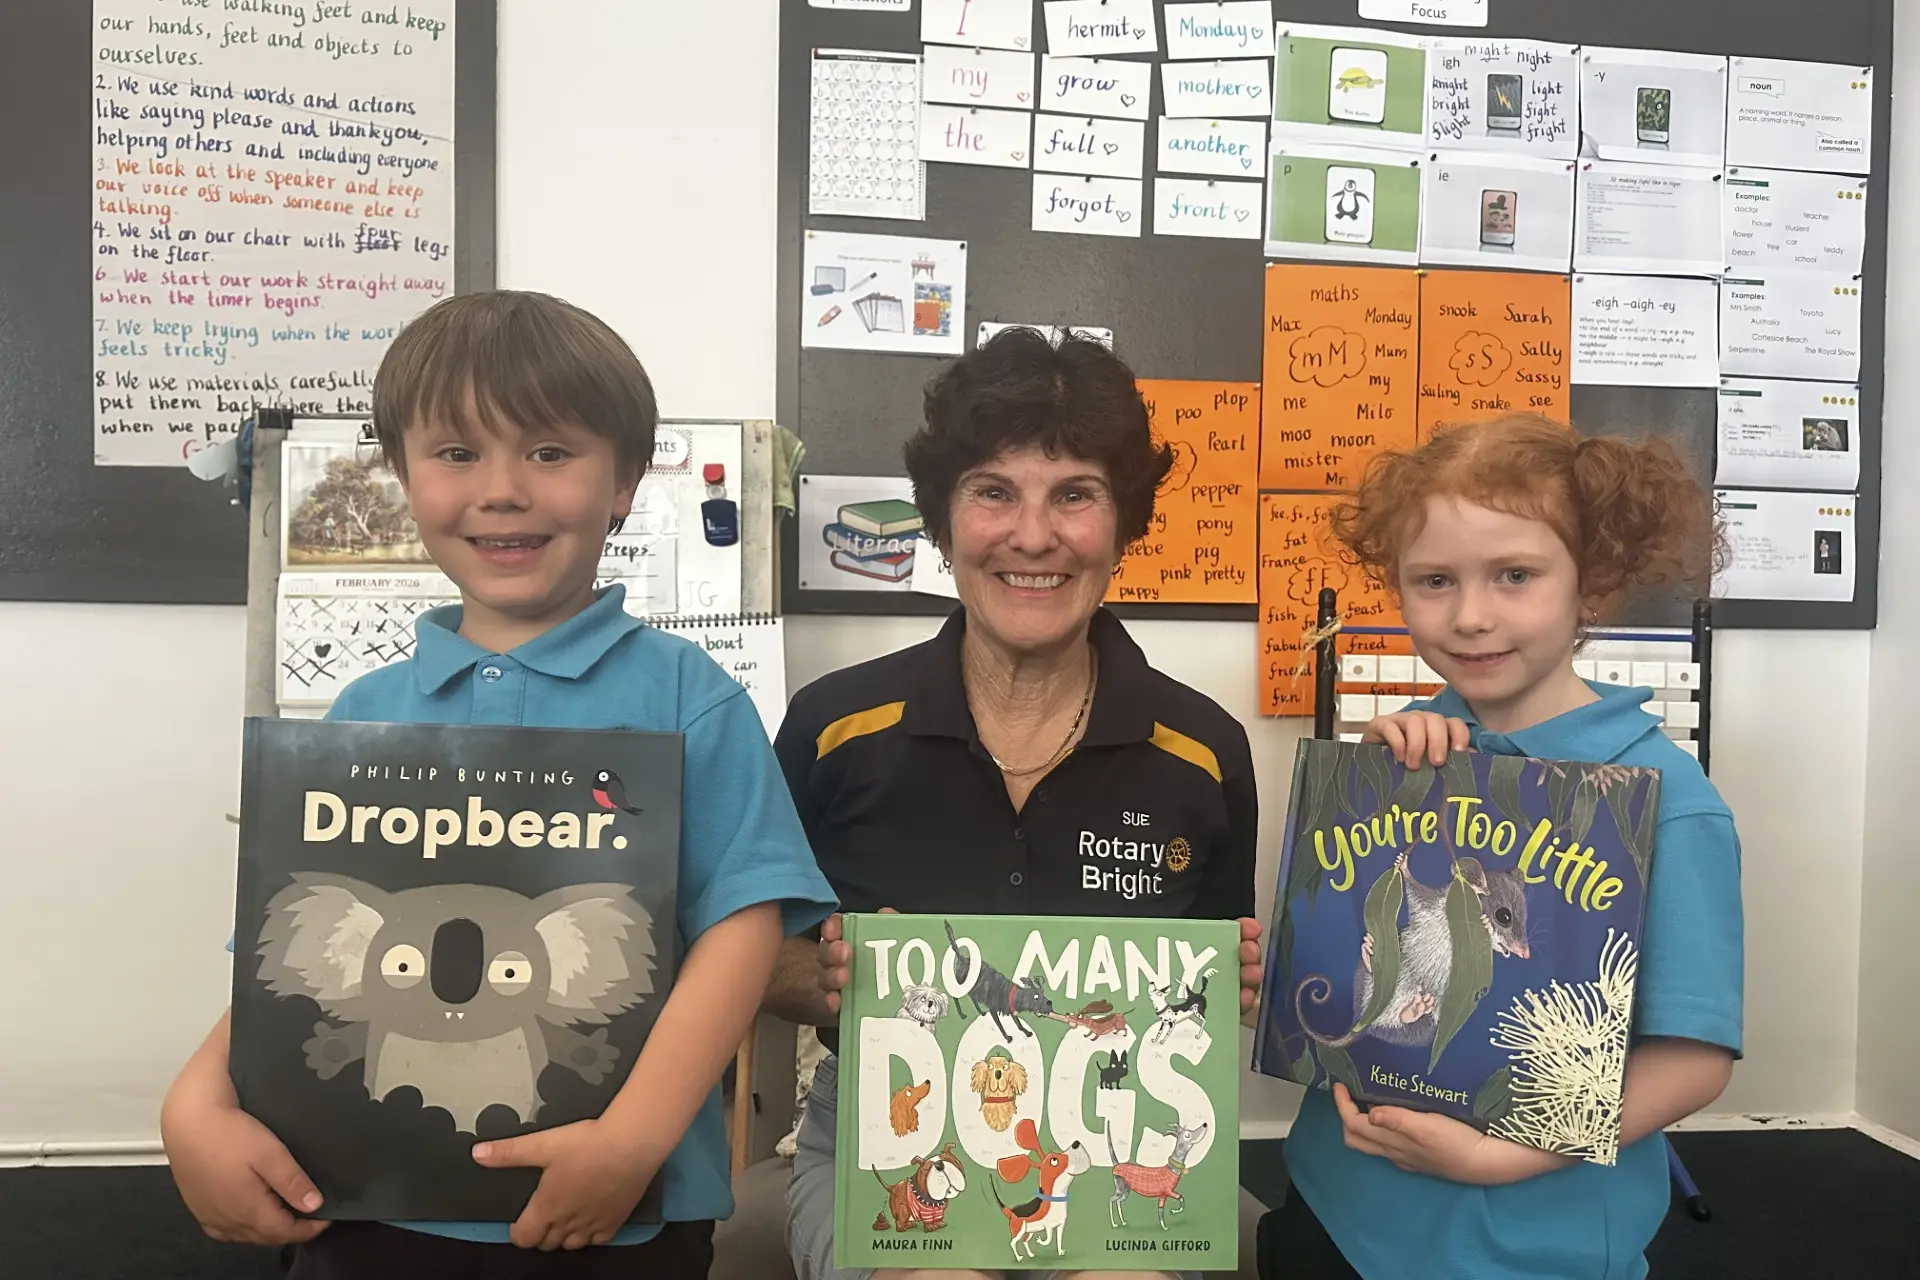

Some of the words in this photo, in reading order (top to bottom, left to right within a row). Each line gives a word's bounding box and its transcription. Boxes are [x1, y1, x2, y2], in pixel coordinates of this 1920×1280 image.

[313, 0, 352, 22] feet
[361, 6, 399, 25] and
[405, 6, 446, 41] keep
[1411, 3, 1447, 19] Focus
[1068, 15, 1131, 39] hermit
[1180, 18, 1248, 48] Monday
[100, 17, 135, 31] our
[149, 16, 211, 40] hands,
[220, 22, 258, 48] feet
[268, 31, 304, 49] and
[314, 32, 380, 60] objects
[393, 40, 413, 56] to
[99, 44, 203, 65] ourselves.
[1465, 42, 1510, 61] might
[1517, 50, 1553, 72] night
[1442, 56, 1461, 69] igh
[952, 67, 988, 98] my
[1056, 74, 1120, 97] grow
[1178, 76, 1247, 98] mother
[1432, 76, 1468, 98] knight
[1532, 80, 1563, 102] light
[1750, 82, 1773, 91] noun
[118, 76, 140, 95] We
[150, 83, 179, 96] use
[190, 78, 234, 100] kind
[244, 86, 295, 106] words
[303, 92, 340, 110] and
[348, 96, 416, 115] actions
[96, 97, 130, 118] like
[140, 103, 205, 130] saying
[213, 108, 272, 129] please
[281, 119, 319, 138] and
[1432, 97, 1470, 118] bright
[1525, 103, 1557, 124] fight
[945, 120, 985, 152] the
[1432, 114, 1471, 140] flight
[1527, 118, 1566, 142] fright
[97, 126, 167, 158] helping
[175, 132, 232, 153] others
[245, 141, 285, 160] and
[299, 145, 371, 175] including
[1044, 129, 1096, 155] full
[1168, 134, 1249, 158] another
[1835, 138, 1853, 146] called
[1283, 163, 1292, 175] p
[1438, 169, 1450, 182] ie
[116, 158, 141, 175] We
[149, 158, 186, 177] look
[196, 164, 217, 179] at
[227, 162, 256, 182] the
[264, 168, 336, 192] speaker
[345, 178, 379, 196] and
[387, 178, 424, 202] keep
[1044, 186, 1116, 223] forgot
[1168, 193, 1230, 220] front
[1735, 192, 1771, 201] Examples:
[1803, 212, 1830, 220] teacher
[98, 244, 119, 256] on
[132, 244, 159, 260] the
[164, 245, 215, 265] floor.
[1731, 249, 1756, 257] beach
[1794, 255, 1817, 263] school
[1824, 246, 1845, 255] teddy
[100, 288, 153, 305] when
[168, 288, 195, 305] the
[207, 289, 254, 308] timer
[1310, 284, 1360, 302] maths
[1365, 308, 1412, 330] Monday
[1504, 302, 1553, 325] Sarah
[1751, 318, 1780, 326] Australia
[1800, 309, 1824, 317] Toyota
[1271, 315, 1302, 333] Max
[1825, 328, 1842, 336] Lucy
[1375, 343, 1408, 360] Mum
[1520, 341, 1563, 366] Sally
[1818, 348, 1837, 356] Royal
[1369, 374, 1391, 395] my
[1515, 368, 1561, 390] Sassy
[1214, 389, 1249, 412] plop
[1283, 396, 1308, 411] me
[1471, 394, 1511, 411] snake
[1529, 394, 1554, 407] see
[1175, 407, 1202, 425] poo
[1356, 403, 1395, 420] Milo
[1208, 431, 1245, 451] Pearl
[1281, 428, 1312, 443] moo
[1331, 434, 1376, 448] moon
[1285, 451, 1343, 469] mister
[1326, 472, 1347, 486] Mr
[1191, 482, 1243, 502] pepper
[1197, 518, 1233, 537] pony
[833, 532, 914, 553] Literac
[1283, 531, 1308, 550] fat
[604, 541, 649, 562] Preps
[1195, 542, 1220, 567] pig
[1262, 554, 1306, 569] France
[336, 578, 391, 588] FEBRUARY
[394, 578, 421, 588] 2026
[1160, 563, 1192, 585] pink
[1204, 565, 1245, 585] pretty
[1119, 586, 1160, 600] puppy
[1267, 606, 1298, 624] fish
[1345, 600, 1385, 619] feast
[1346, 635, 1388, 654] fried
[734, 660, 758, 671] can
[1272, 687, 1300, 707] fun
[350, 764, 438, 782] PHILIP
[458, 767, 575, 786] BUNTING
[302, 790, 629, 859] Dropbear.
[1122, 811, 1150, 826] SUE
[1078, 830, 1165, 868] Rotary
[1447, 796, 1517, 857] Too
[1518, 818, 1625, 912] Little
[1082, 864, 1163, 900] Bright
[865, 937, 982, 999] TOO
[1012, 929, 1219, 1002] MANY
[858, 1011, 1216, 1171] DOGS
[1370, 1064, 1408, 1090] Katie
[1410, 1074, 1469, 1106] Stewart
[872, 1238, 918, 1251] MAURA
[923, 1238, 953, 1251] FINN
[1106, 1238, 1157, 1252] LUCINDA
[1162, 1238, 1211, 1252] GIFFORD
